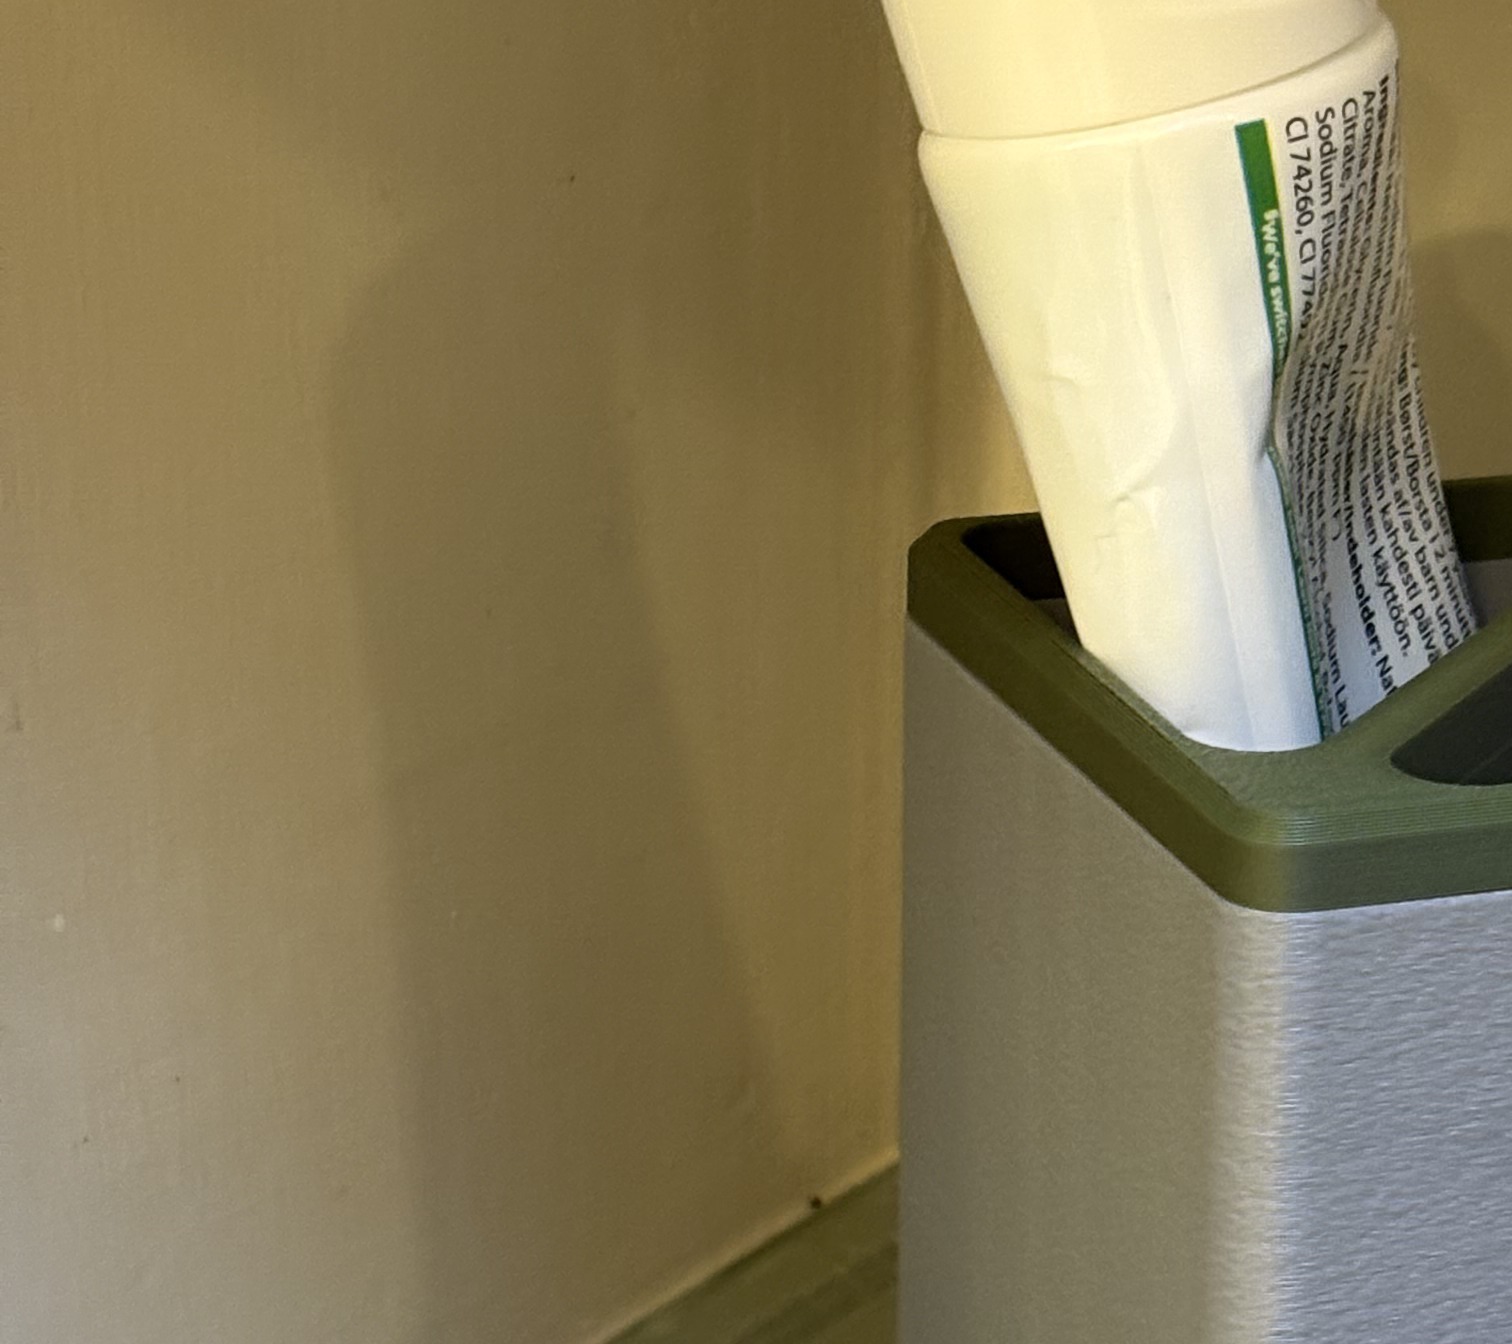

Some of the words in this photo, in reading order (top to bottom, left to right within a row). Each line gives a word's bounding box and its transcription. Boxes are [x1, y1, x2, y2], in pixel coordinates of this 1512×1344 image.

[1315, 106, 1338, 206] Sodium
[1339, 98, 1359, 188] Citrate,
[1356, 90, 1377, 178] Aroma,
[1289, 147, 1315, 235] 74260,
[1380, 501, 1421, 601] kahdesti
[1414, 546, 1441, 601] barn
